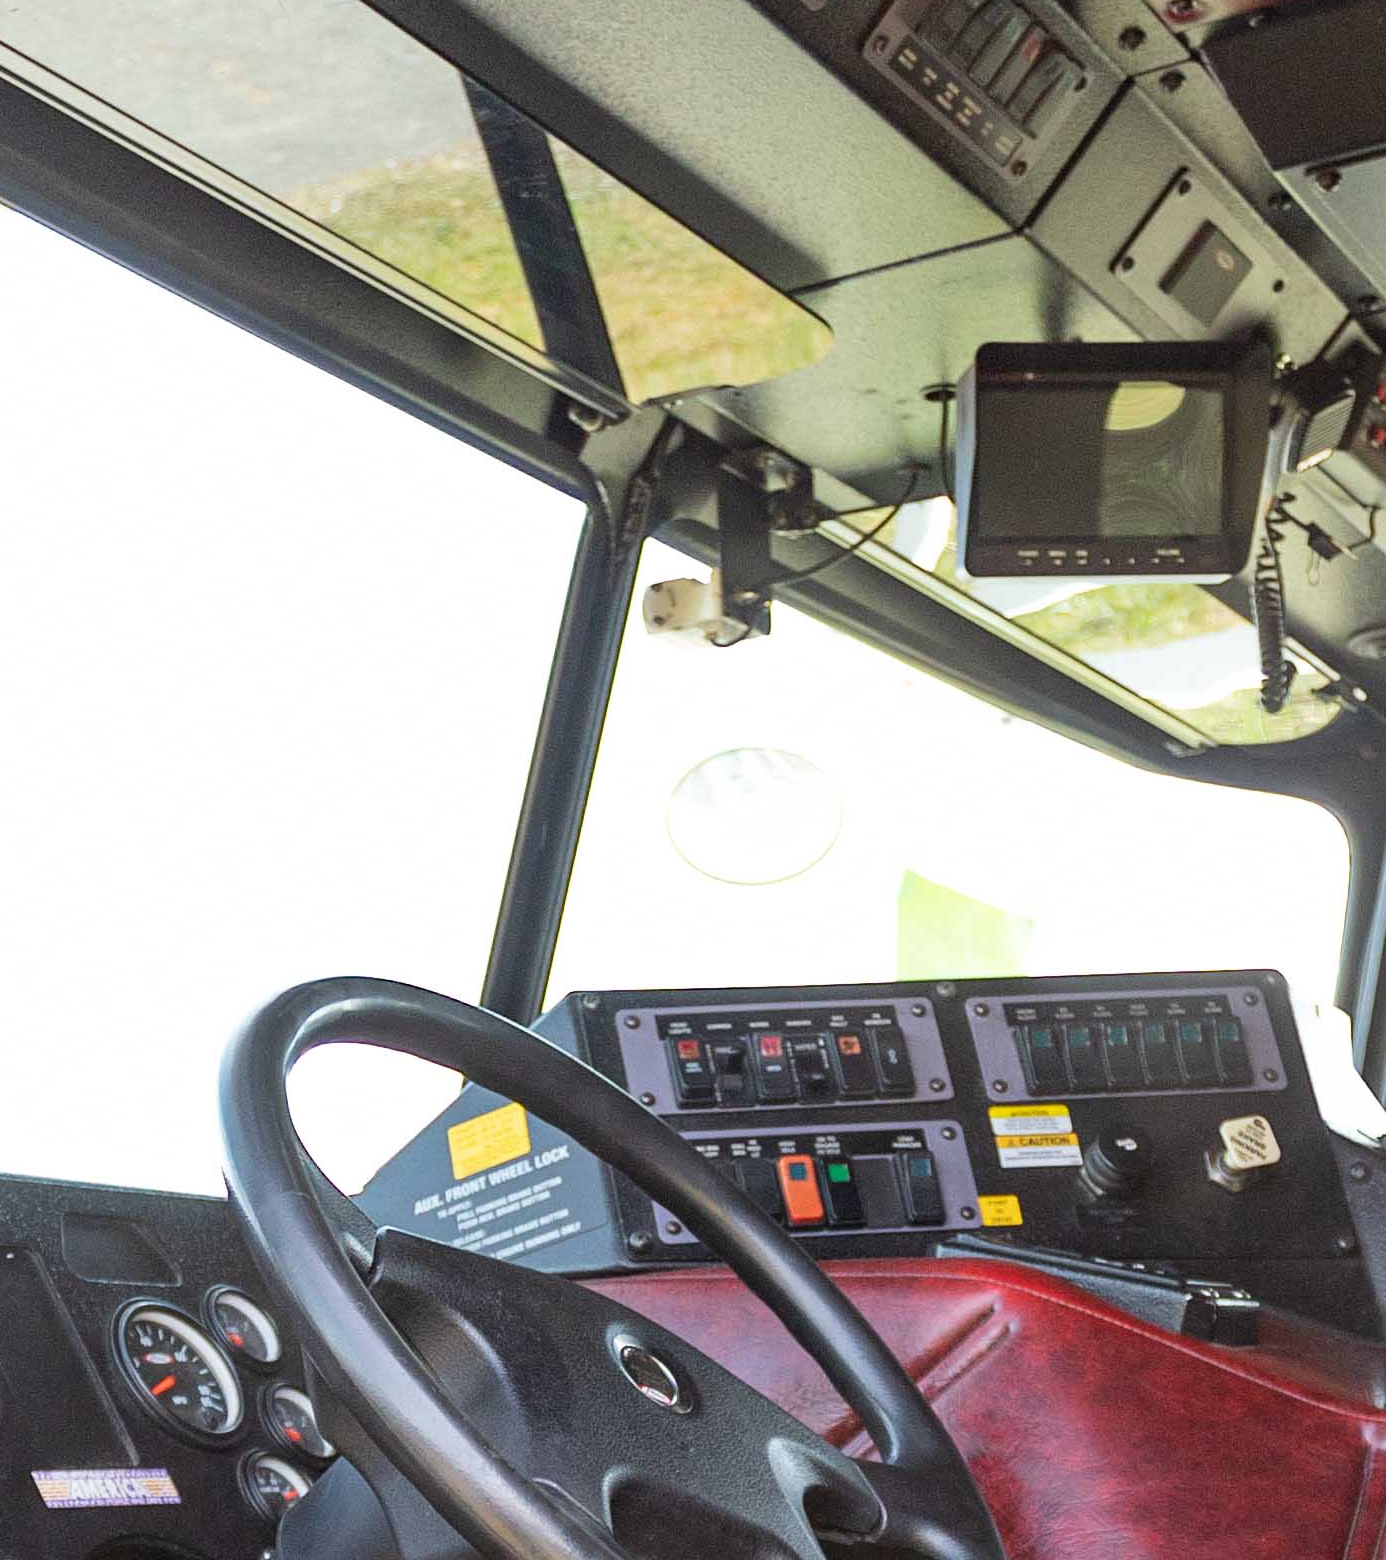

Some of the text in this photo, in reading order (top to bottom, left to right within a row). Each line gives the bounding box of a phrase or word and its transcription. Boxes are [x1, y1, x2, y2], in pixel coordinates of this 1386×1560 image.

[1020, 1137, 1070, 1145] CAUTION
[414, 1145, 570, 1215] AUX. FRONT WHEEL LOCK
